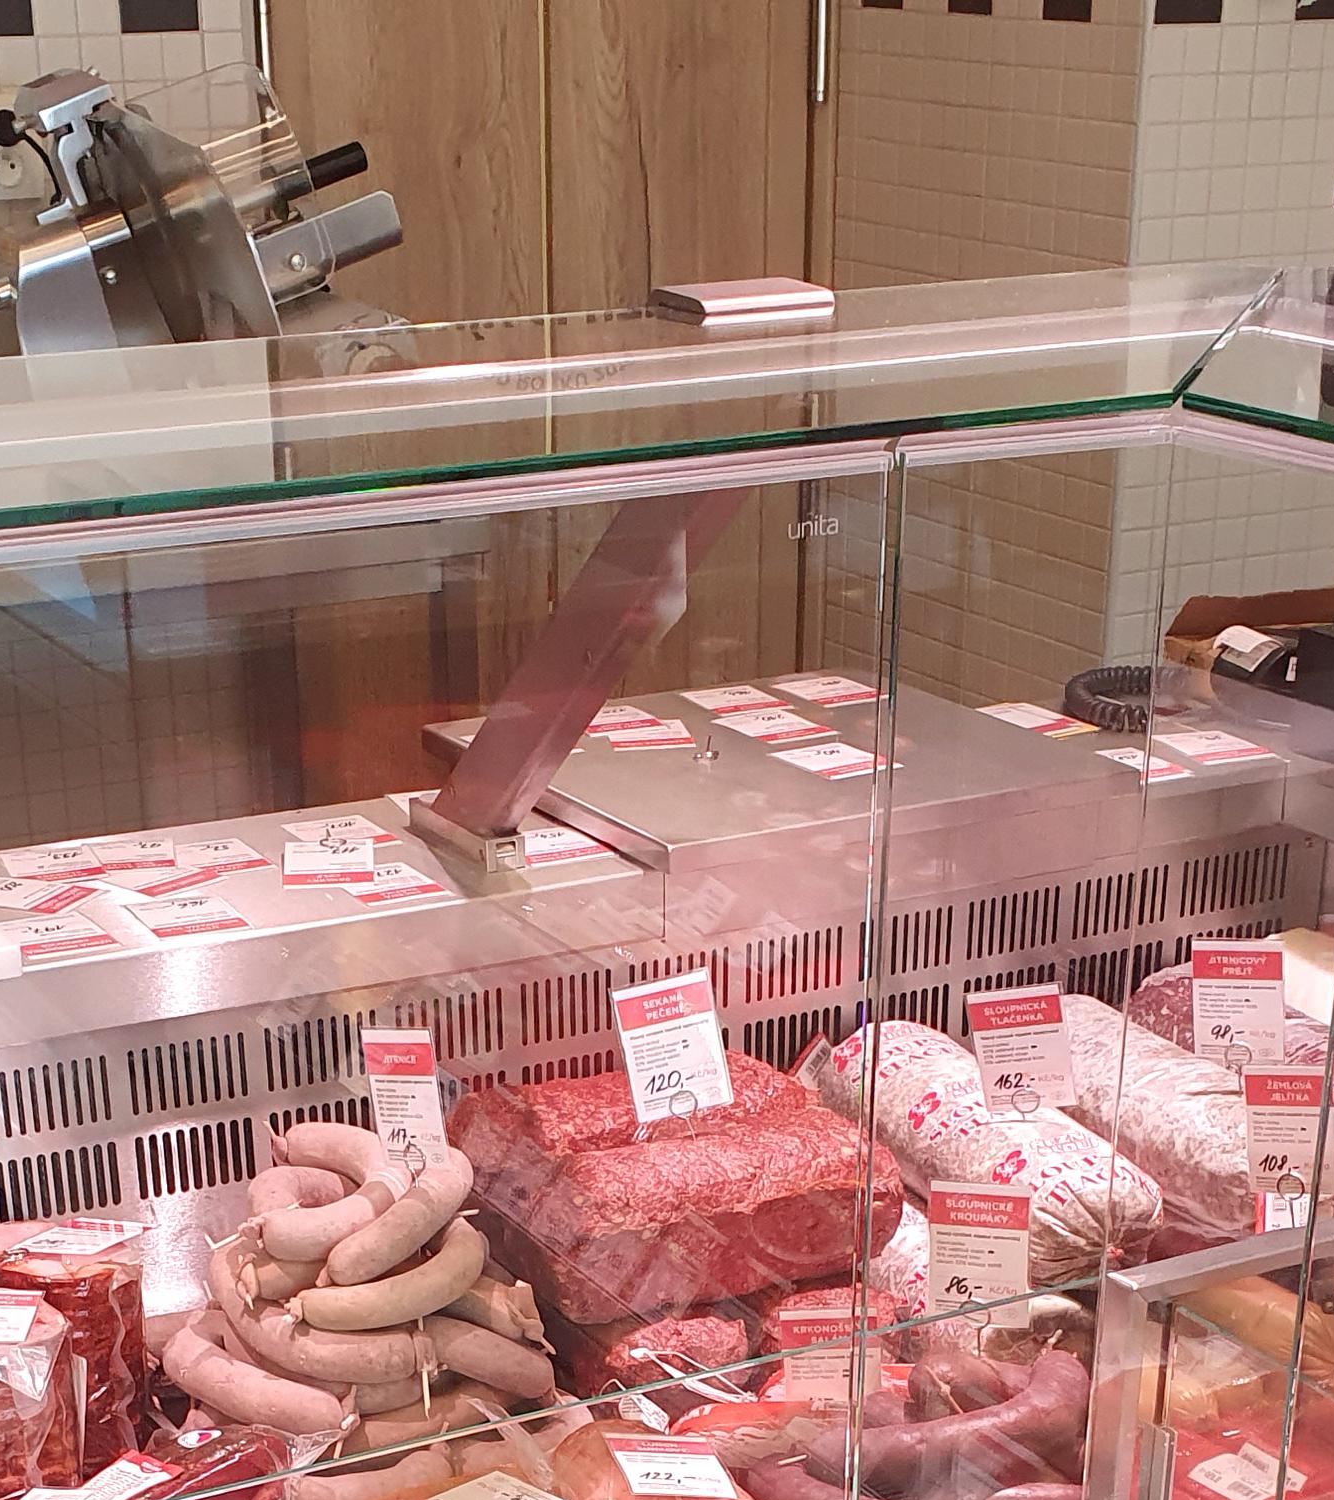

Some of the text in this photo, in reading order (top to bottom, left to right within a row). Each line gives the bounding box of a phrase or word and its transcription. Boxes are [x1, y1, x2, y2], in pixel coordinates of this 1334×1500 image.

[788, 514, 839, 539] unita
[990, 1013, 1045, 1026] TLAČENKA
[644, 1070, 694, 1095] 120,-
[1259, 1153, 1299, 1173] 108,-
